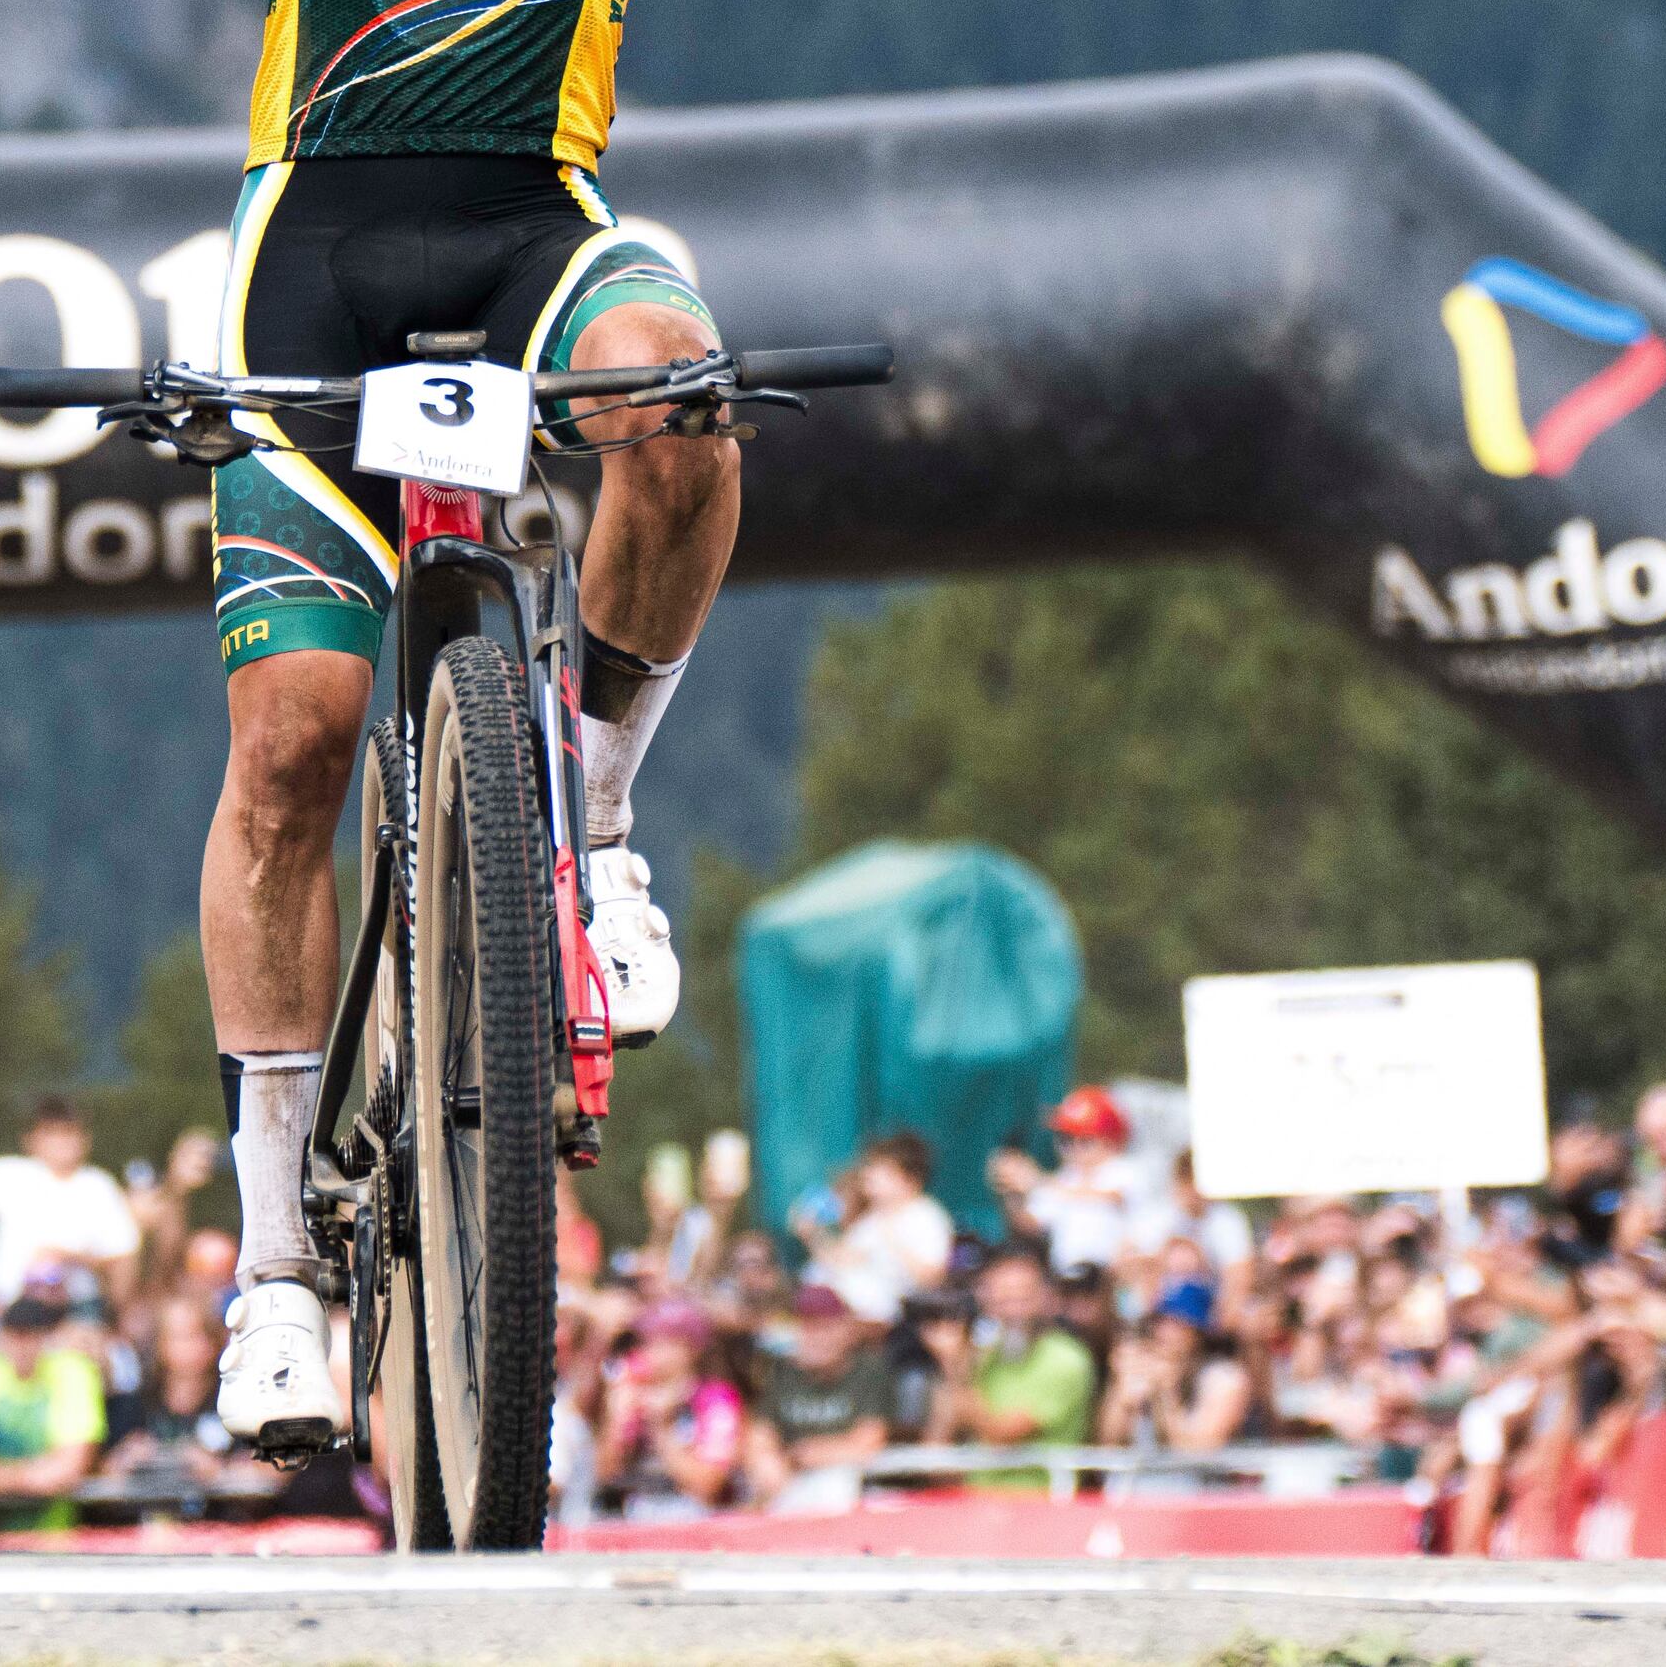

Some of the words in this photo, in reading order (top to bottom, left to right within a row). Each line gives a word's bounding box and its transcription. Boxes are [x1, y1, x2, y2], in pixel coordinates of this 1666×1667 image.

[434, 336, 470, 344] GARMIN
[419, 377, 475, 427] 3
[411, 449, 494, 478] Andorra
